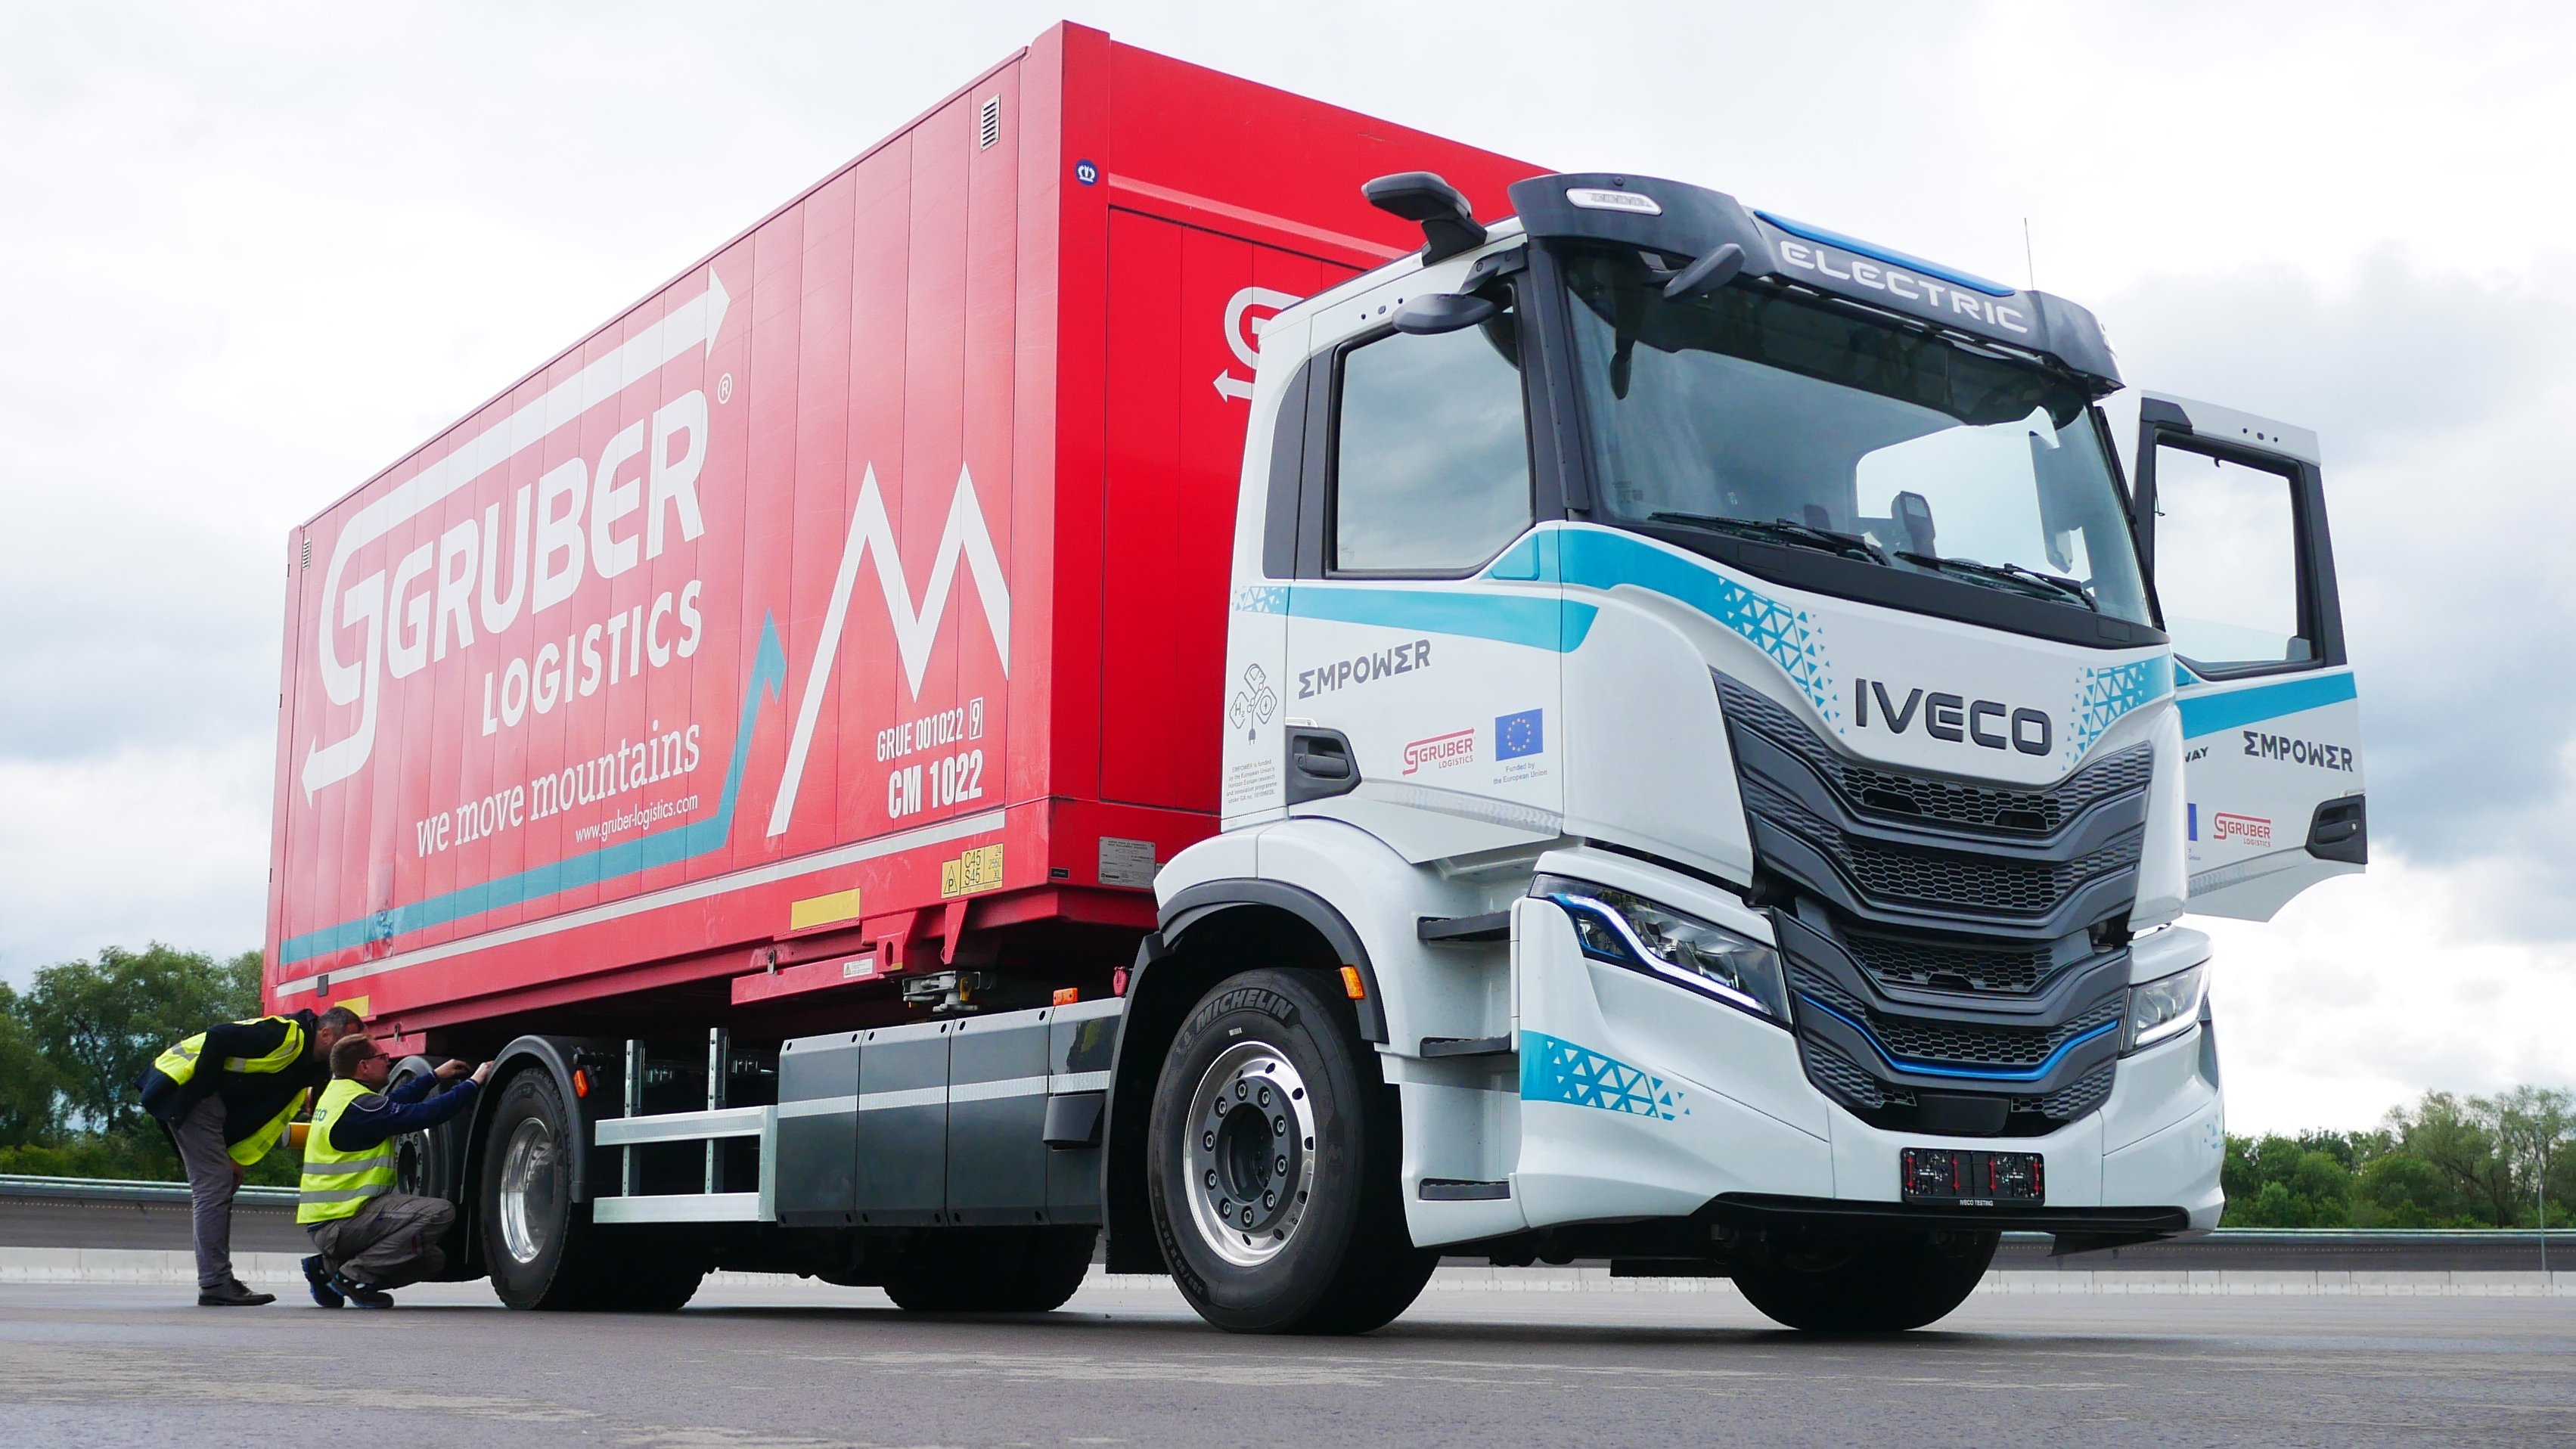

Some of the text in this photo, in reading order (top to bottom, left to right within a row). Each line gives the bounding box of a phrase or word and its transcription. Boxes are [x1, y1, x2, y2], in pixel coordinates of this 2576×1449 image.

[1780, 240, 2029, 334] ELECTRIC
[386, 389, 709, 679] GRUBER
[482, 579, 703, 737] LOGISTICS
[877, 721, 912, 762] GRUE
[916, 707, 964, 751] 001022
[1855, 678, 2053, 757] IVECO
[1419, 737, 1473, 762] GRUBER
[1439, 755, 1473, 769] LOGISTICS
[1506, 762, 1526, 773] Funded
[416, 719, 700, 858] we move mountains
[888, 749, 983, 819] CM 1022
[1493, 769, 1548, 785] the European Union
[576, 794, 698, 842] www.gruber-logistics.com
[2227, 823, 2271, 839] GRUBER
[965, 850, 981, 869] C45
[2243, 838, 2271, 848] LOGISTICS
[964, 867, 981, 886] S45
[1196, 989, 1294, 1033] MICHELIN
